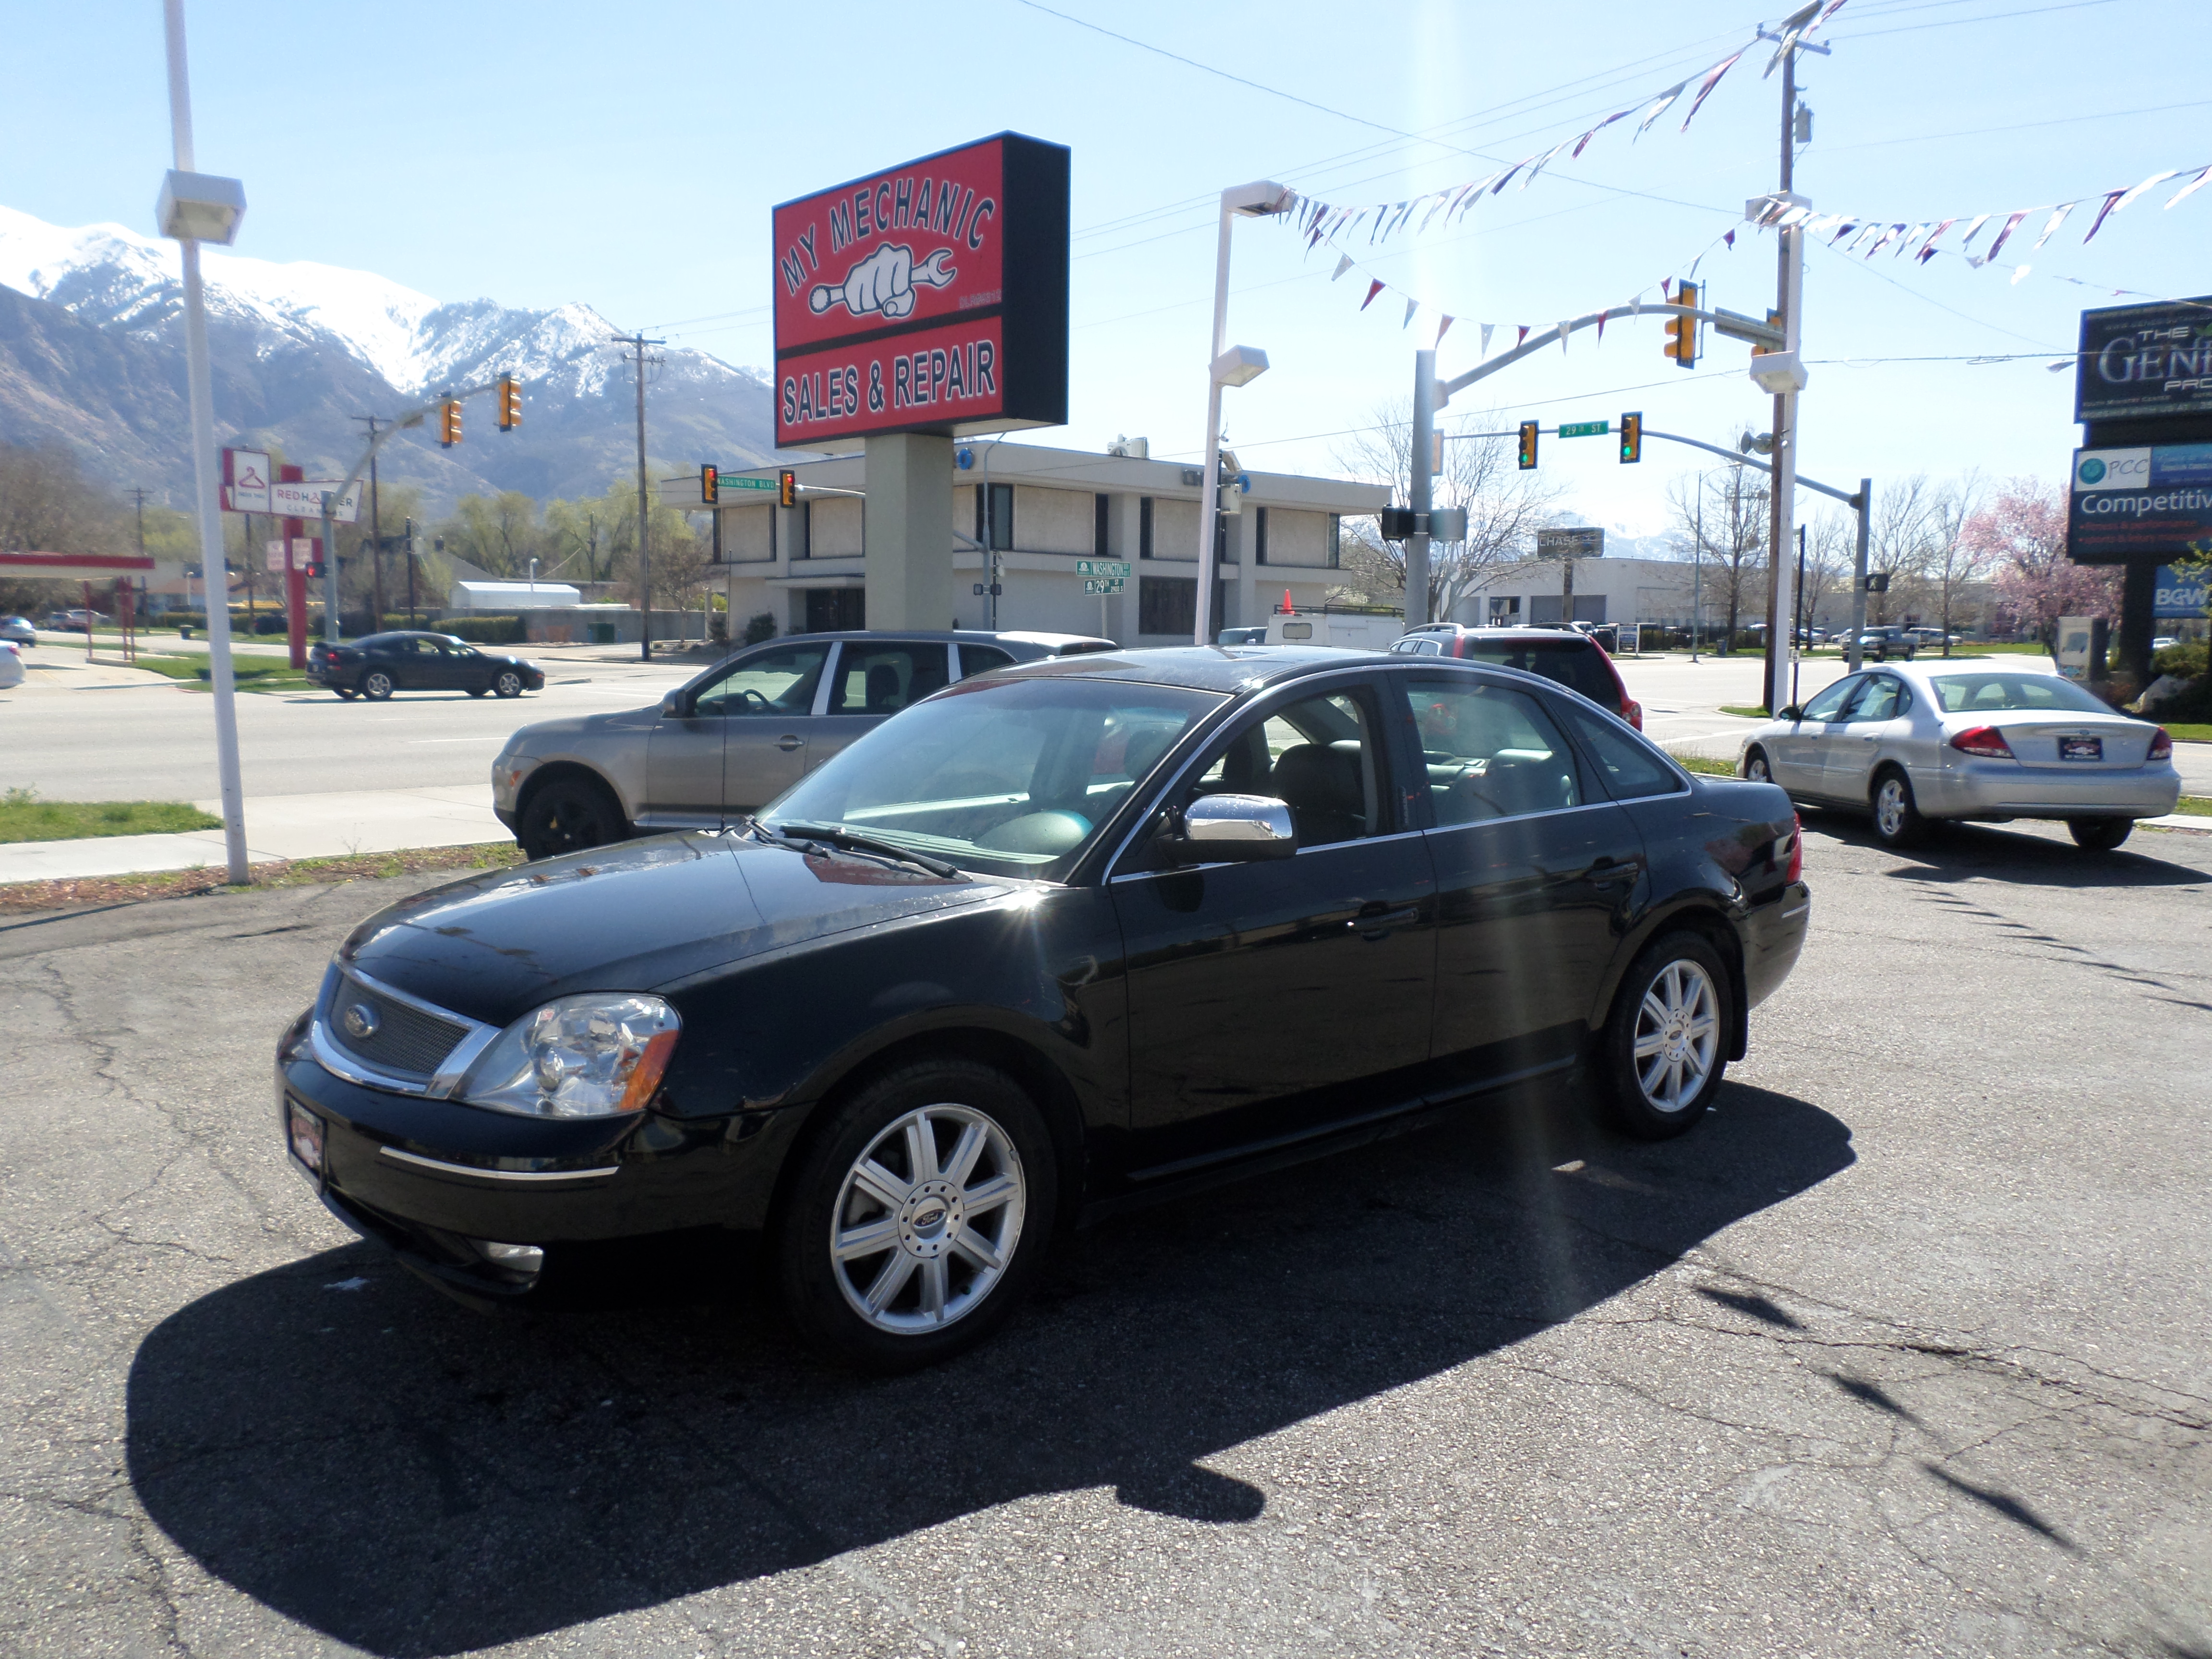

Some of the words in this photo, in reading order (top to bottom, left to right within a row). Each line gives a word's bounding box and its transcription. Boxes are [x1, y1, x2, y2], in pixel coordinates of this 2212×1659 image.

[781, 223, 818, 296] MY
[830, 178, 995, 253] MECHANIC
[2138, 326, 2189, 341] THE
[782, 365, 859, 425] SALES
[867, 360, 885, 413] &
[894, 339, 996, 409] REPAIR
[2109, 459, 2148, 479] PCC
[759, 481, 774, 489] BLVD
[1092, 562, 1123, 576] WASHINGTON
[922, 1213, 938, 1225] Ford
